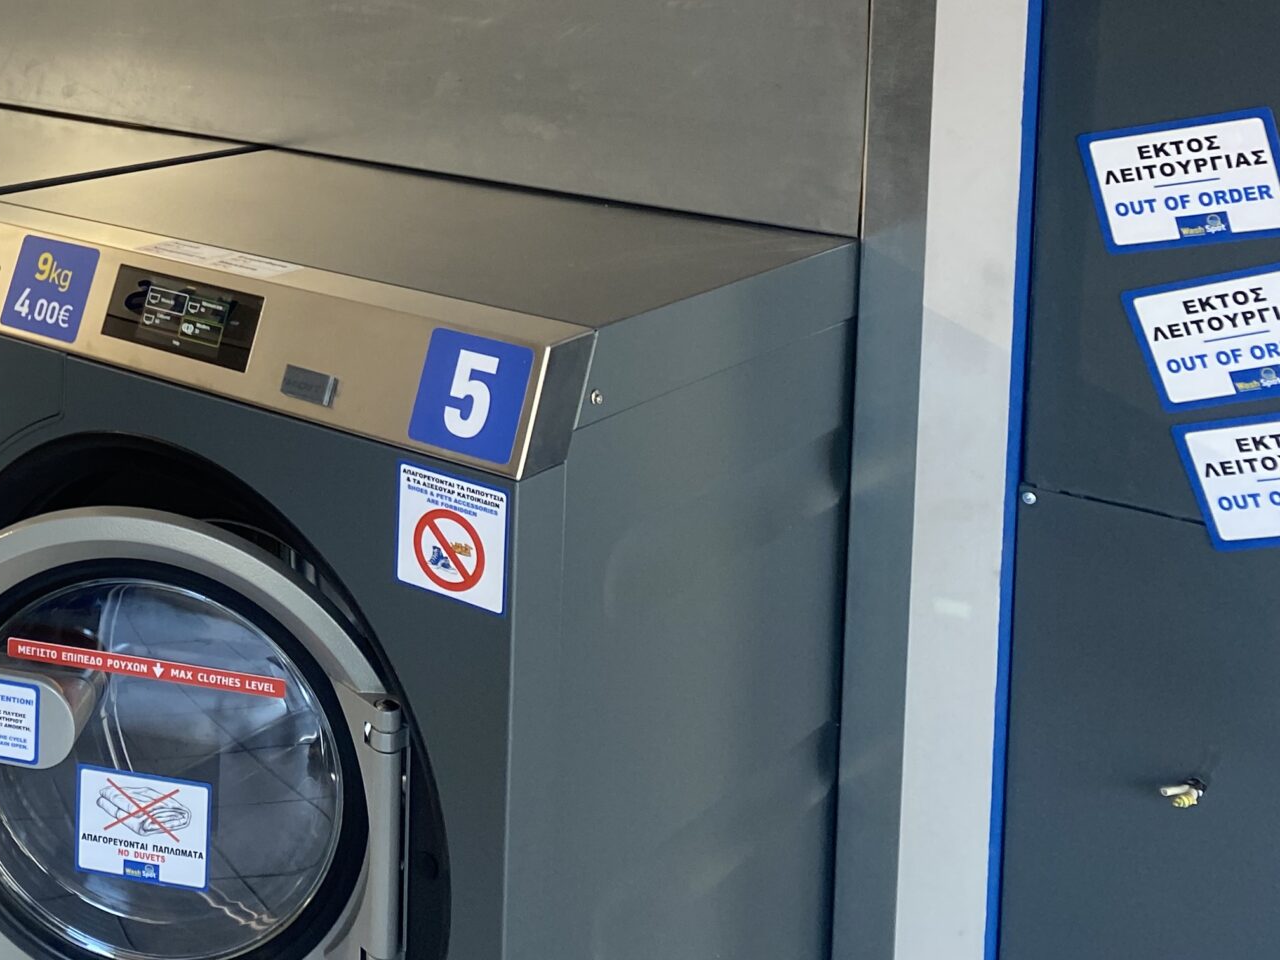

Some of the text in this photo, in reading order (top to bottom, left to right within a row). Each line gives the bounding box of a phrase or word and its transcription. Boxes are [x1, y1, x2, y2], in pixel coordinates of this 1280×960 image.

[1137, 135, 1220, 160] ΕΚΤΟΣ
[1105, 150, 1268, 185] ΛΕΙΤΟΥΡΓΙΑΣ
[1115, 184, 1274, 217] OUT OF ORDER
[34, 251, 73, 293] 9kg
[1182, 287, 1267, 315] ΕΚΤΟΣ
[1154, 306, 1280, 342] ΛΕΙΤΟΥΡΓΙ
[1166, 354, 1208, 374] OUT
[1216, 348, 1242, 366] OF
[442, 348, 501, 439] 5
[1235, 434, 1280, 453] ΕΚΤ
[1218, 490, 1280, 511] OUT O
[18, 645, 276, 693] ΜΕΓΙΣΤΟ ΕΠΙΠΕΔΟ ΡΟΥΧΩΝ MAX CLOTHES LEVEL
[81, 832, 204, 860] ΑΠΑΓΟΡΕΥΟΝΤΑΙ ΠΑΠΛΩΜΑΤΑ
[118, 848, 166, 864] NO DUVETS
